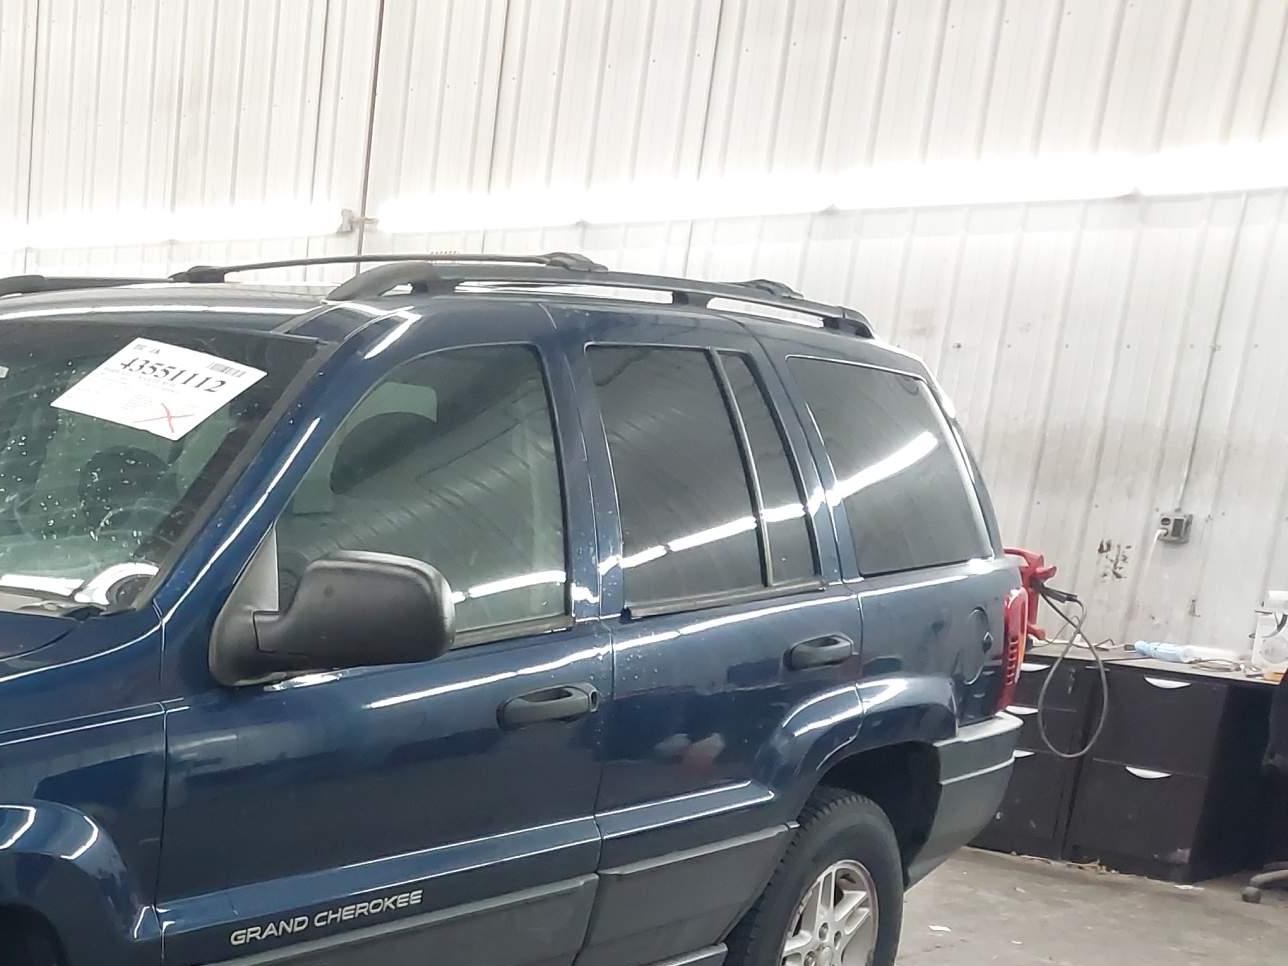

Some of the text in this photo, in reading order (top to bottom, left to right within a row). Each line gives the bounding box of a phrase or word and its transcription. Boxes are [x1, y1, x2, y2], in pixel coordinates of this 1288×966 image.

[120, 356, 227, 393] 43551112
[229, 889, 424, 946] GRAND CHEROKEE
